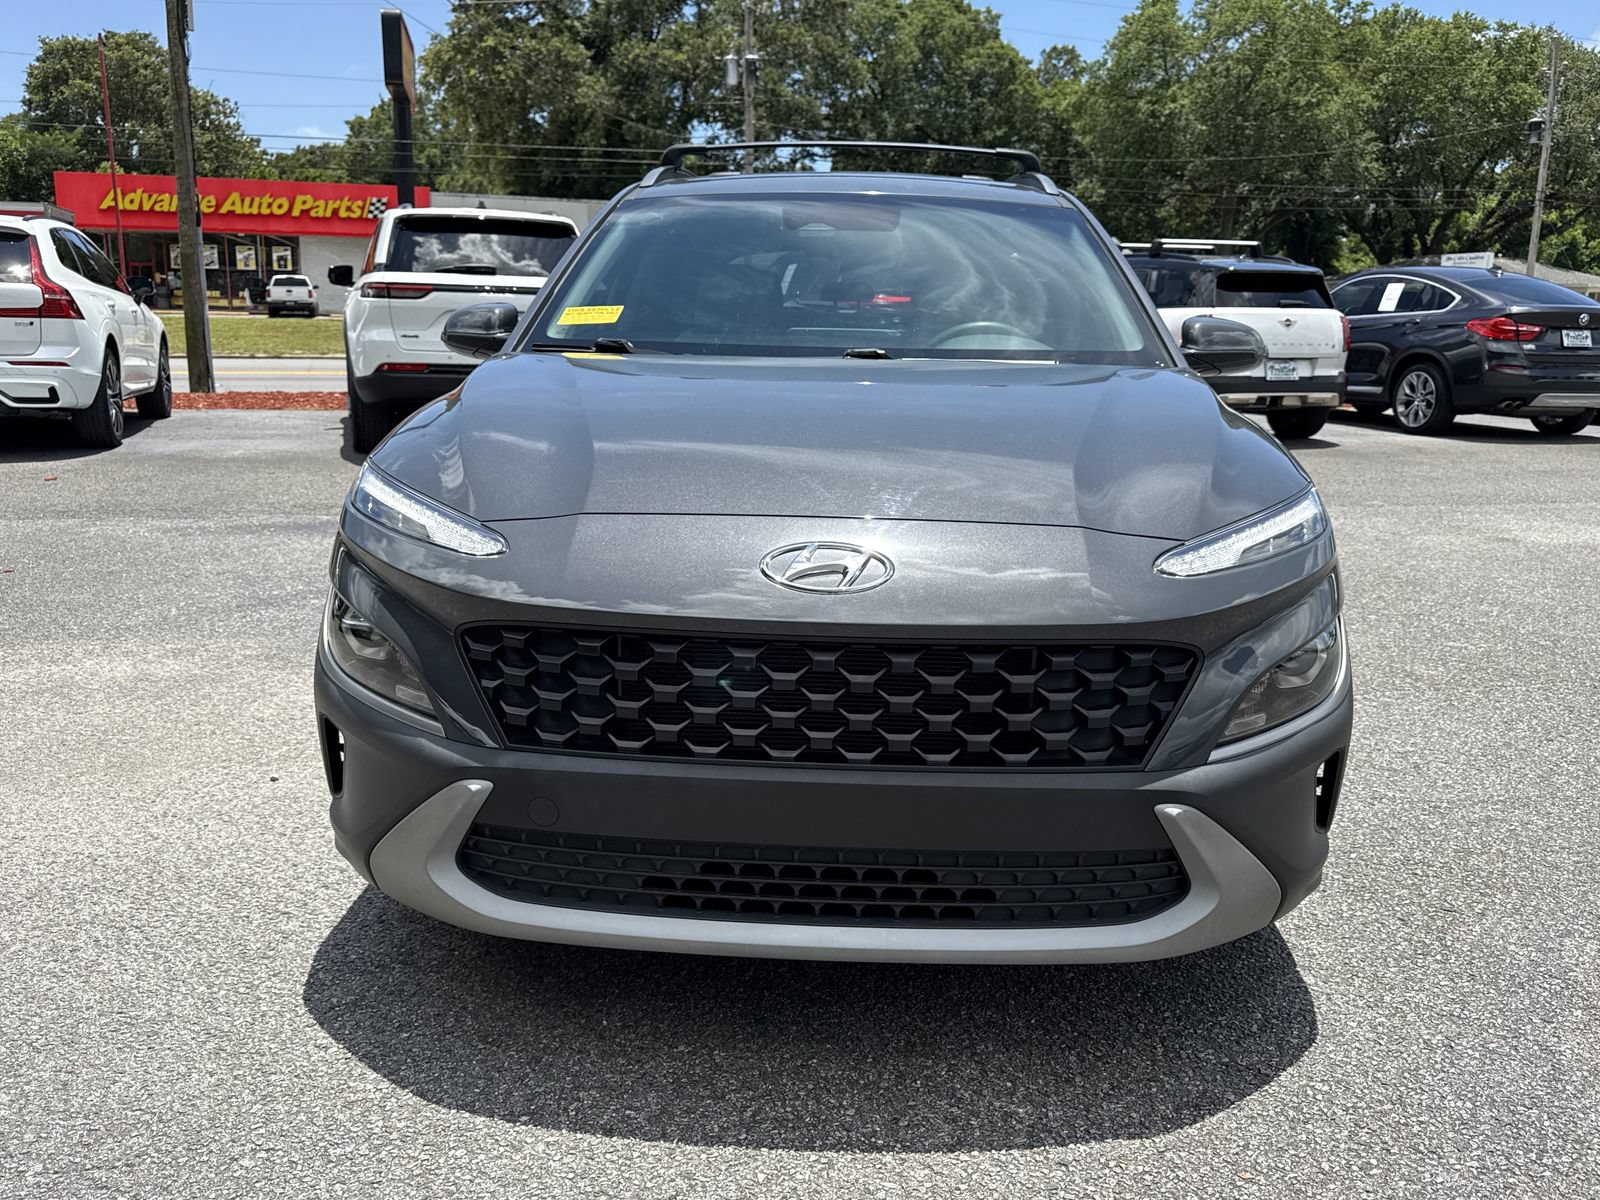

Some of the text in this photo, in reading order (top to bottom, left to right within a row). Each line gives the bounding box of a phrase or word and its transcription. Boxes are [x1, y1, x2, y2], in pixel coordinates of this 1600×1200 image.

[99, 187, 364, 219] Advae Auto Parts
